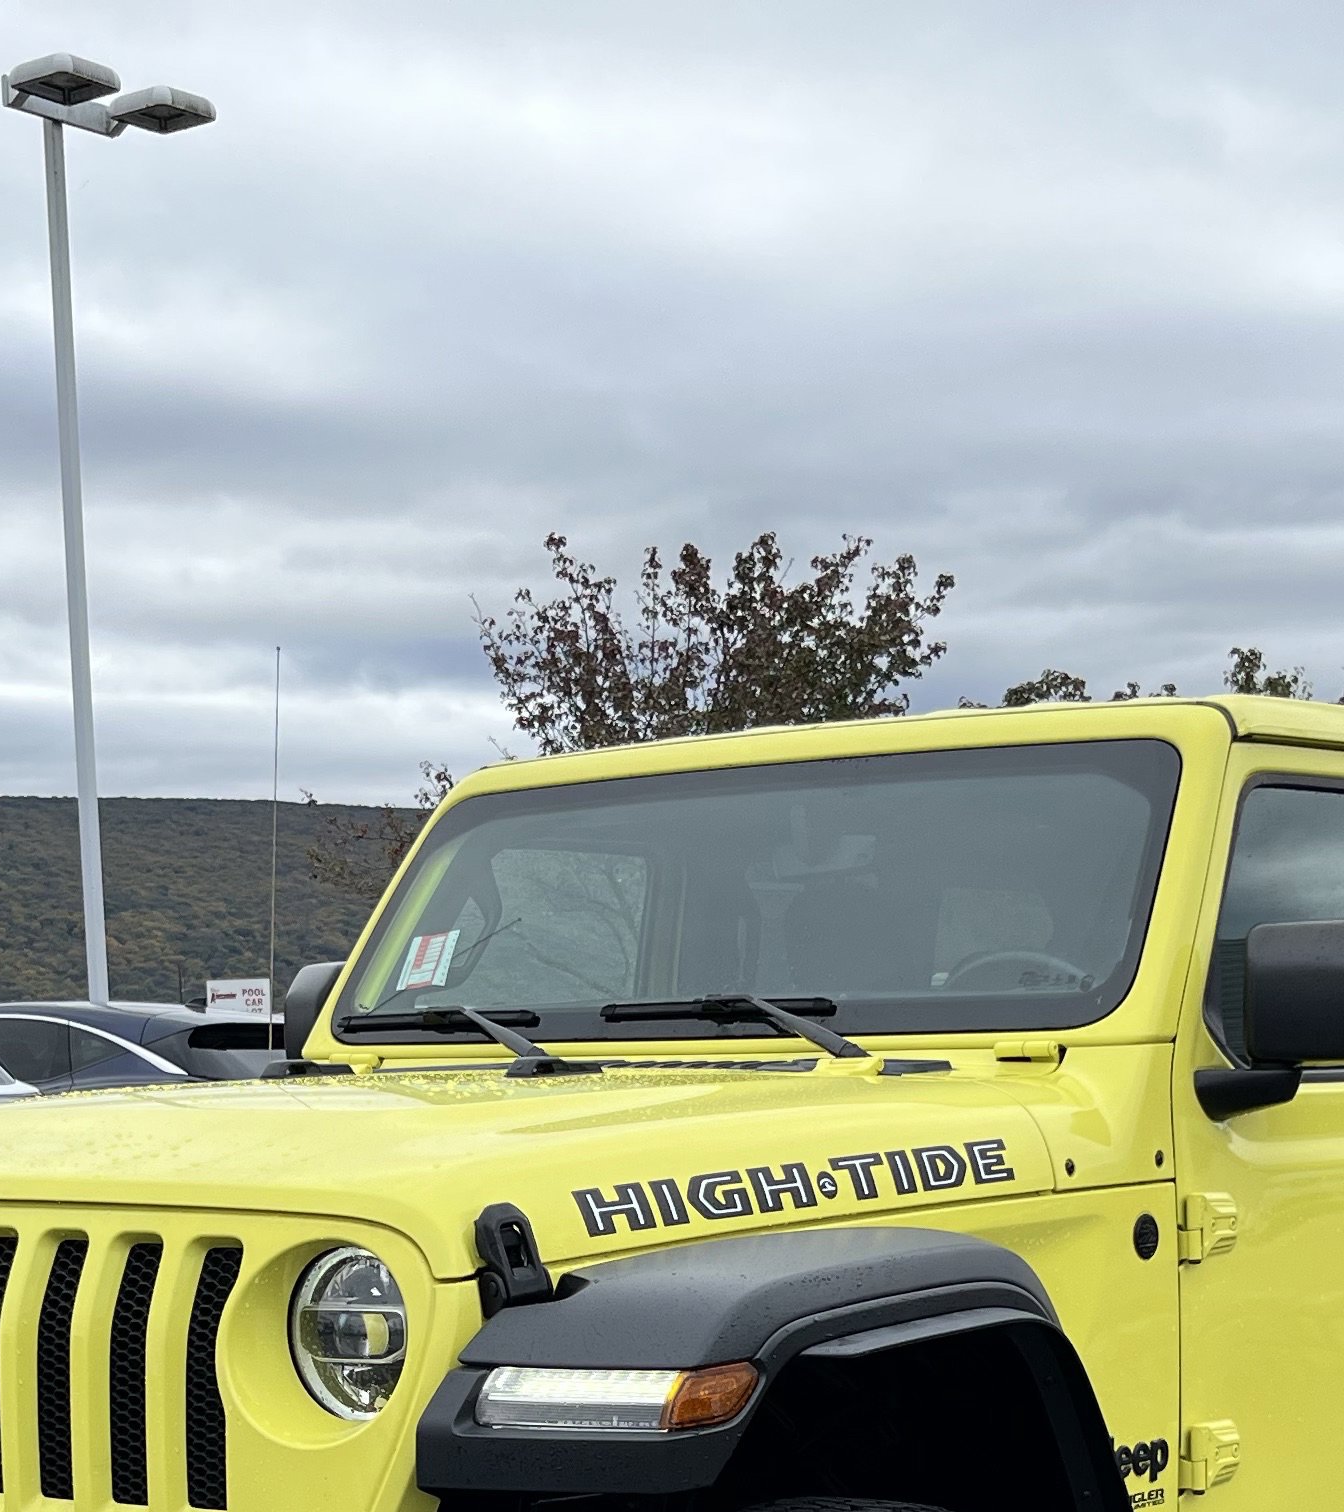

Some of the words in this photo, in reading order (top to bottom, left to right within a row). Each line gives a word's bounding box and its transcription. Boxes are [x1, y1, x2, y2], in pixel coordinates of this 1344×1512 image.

[241, 988, 266, 997] POOL
[245, 998, 263, 1006] CAR
[572, 1163, 817, 1237] HIGH
[829, 1138, 1016, 1200] TIDE
[1111, 1437, 1168, 1483] eep
